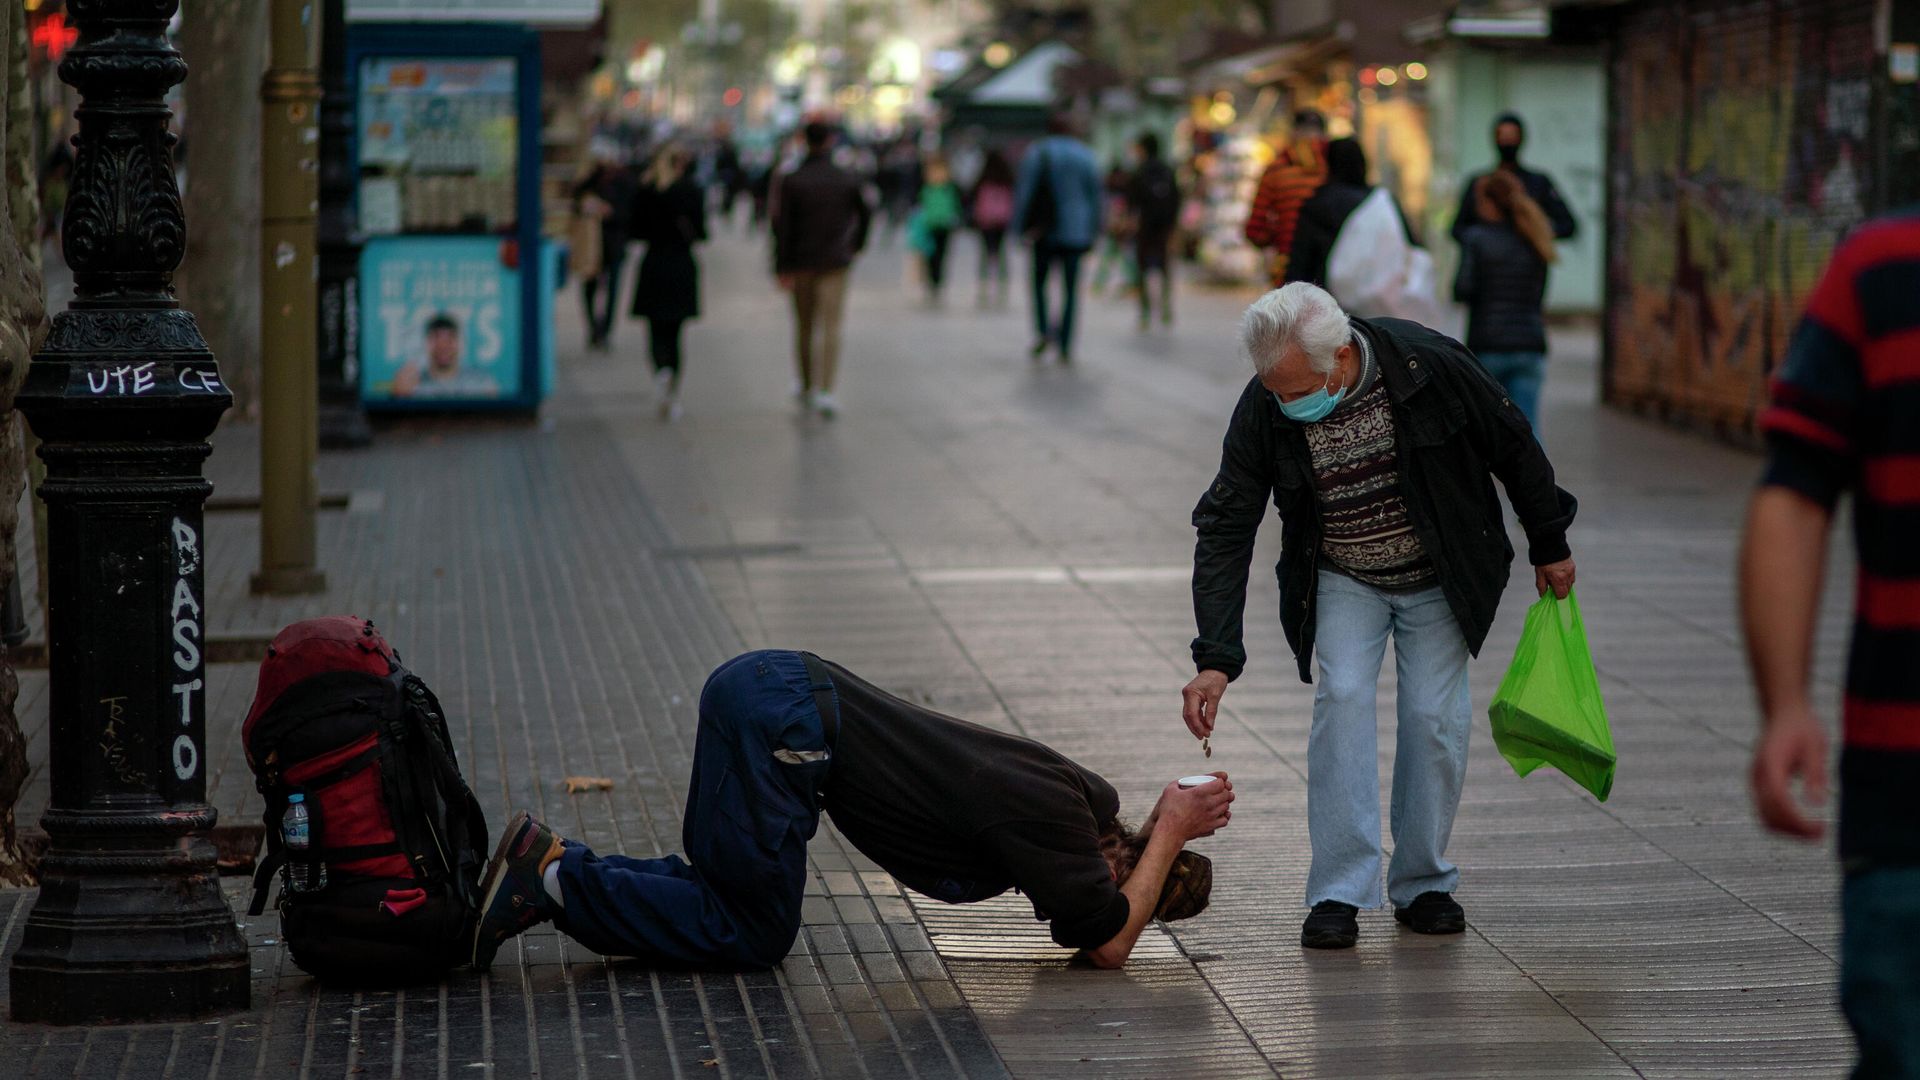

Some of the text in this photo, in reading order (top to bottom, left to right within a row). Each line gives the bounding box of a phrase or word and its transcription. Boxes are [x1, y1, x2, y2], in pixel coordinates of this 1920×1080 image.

[88, 361, 220, 394] UTE CF
[172, 516, 202, 780] BASTO
